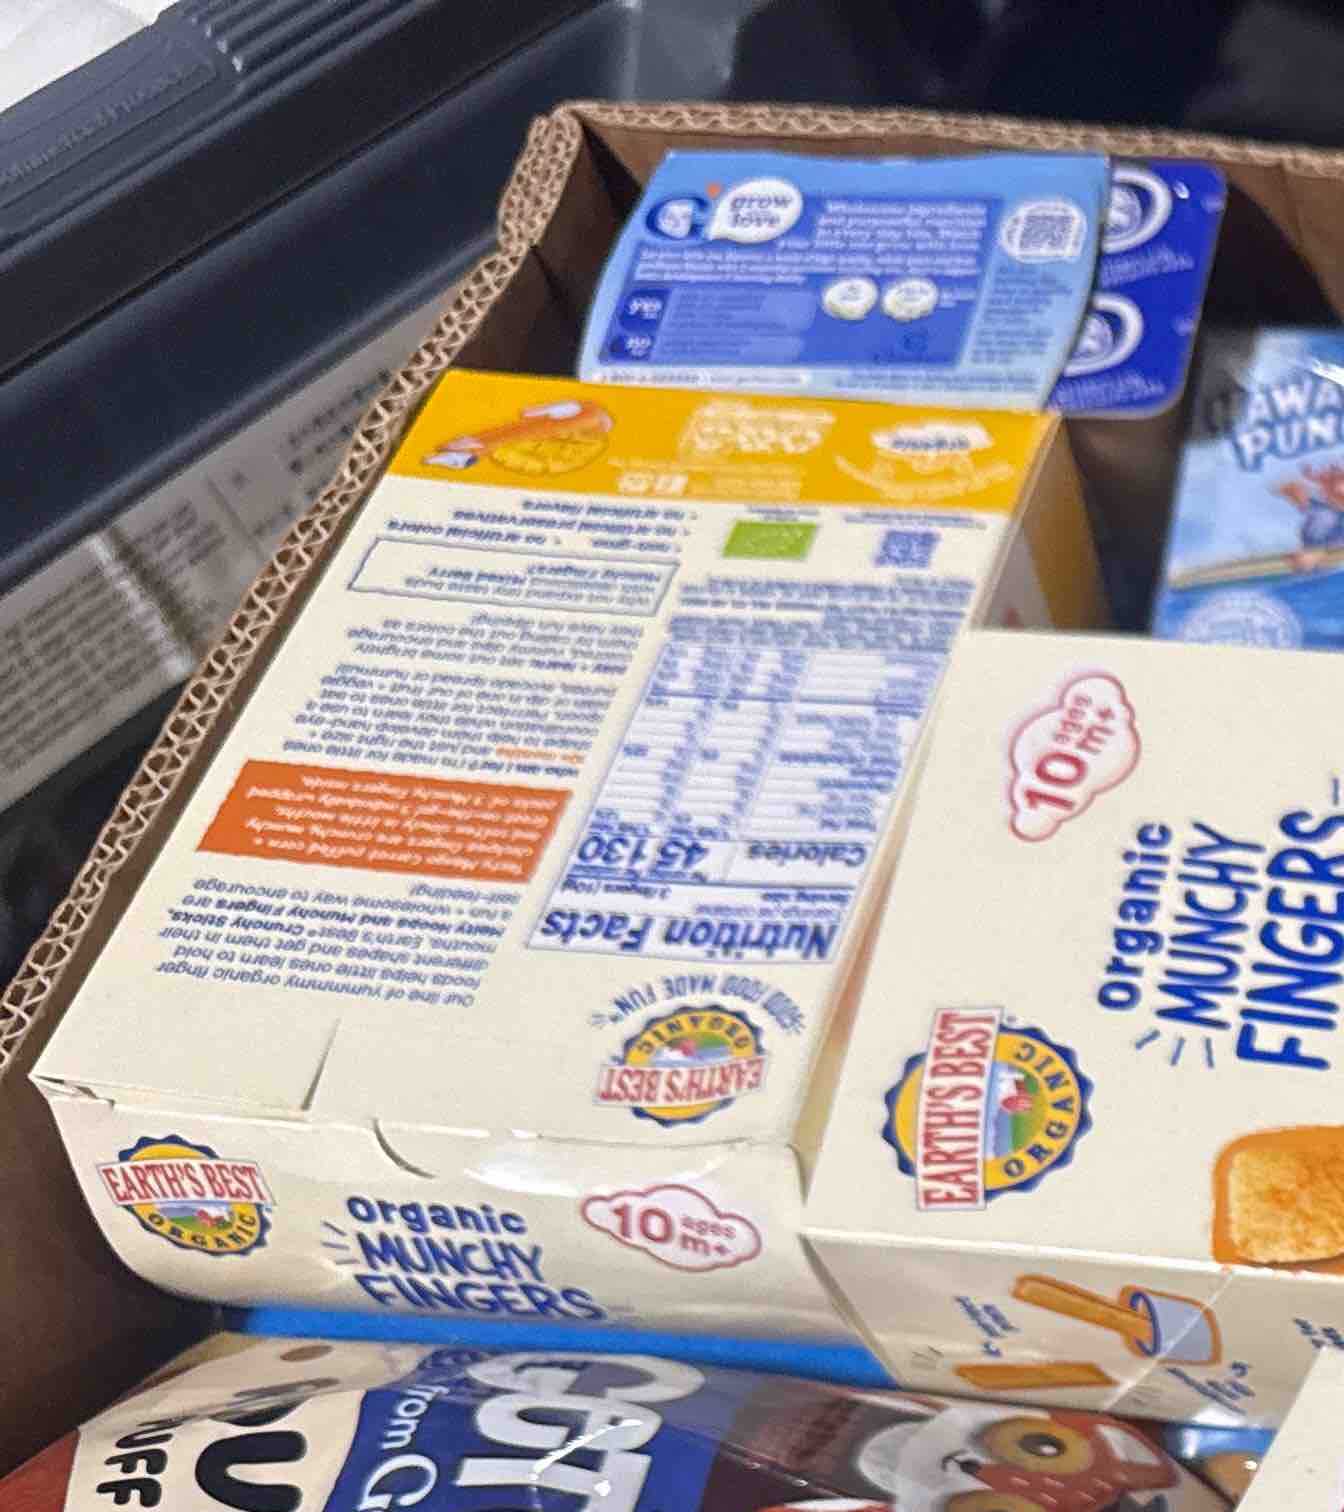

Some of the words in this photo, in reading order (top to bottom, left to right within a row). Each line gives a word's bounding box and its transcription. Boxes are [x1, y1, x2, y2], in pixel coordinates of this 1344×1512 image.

[1026, 750, 1088, 812] 10
[573, 834, 653, 866] 130
[652, 840, 710, 871] 45
[534, 910, 655, 951] Facts
[657, 920, 838, 959] Nutrition
[1098, 821, 1172, 1010] organic
[1155, 821, 1266, 1030] MUNCHY
[930, 1011, 997, 1078] BEST
[1002, 1041, 1076, 1178] ORGANIC
[102, 1163, 201, 1202] EARTH'S
[201, 1162, 267, 1201] BEST
[346, 1196, 526, 1236] organic
[611, 1204, 675, 1244] 10
[356, 1232, 544, 1284] MUNCHY
[354, 1272, 608, 1320] FINGERS
[97, 1418, 184, 1508] UFF
